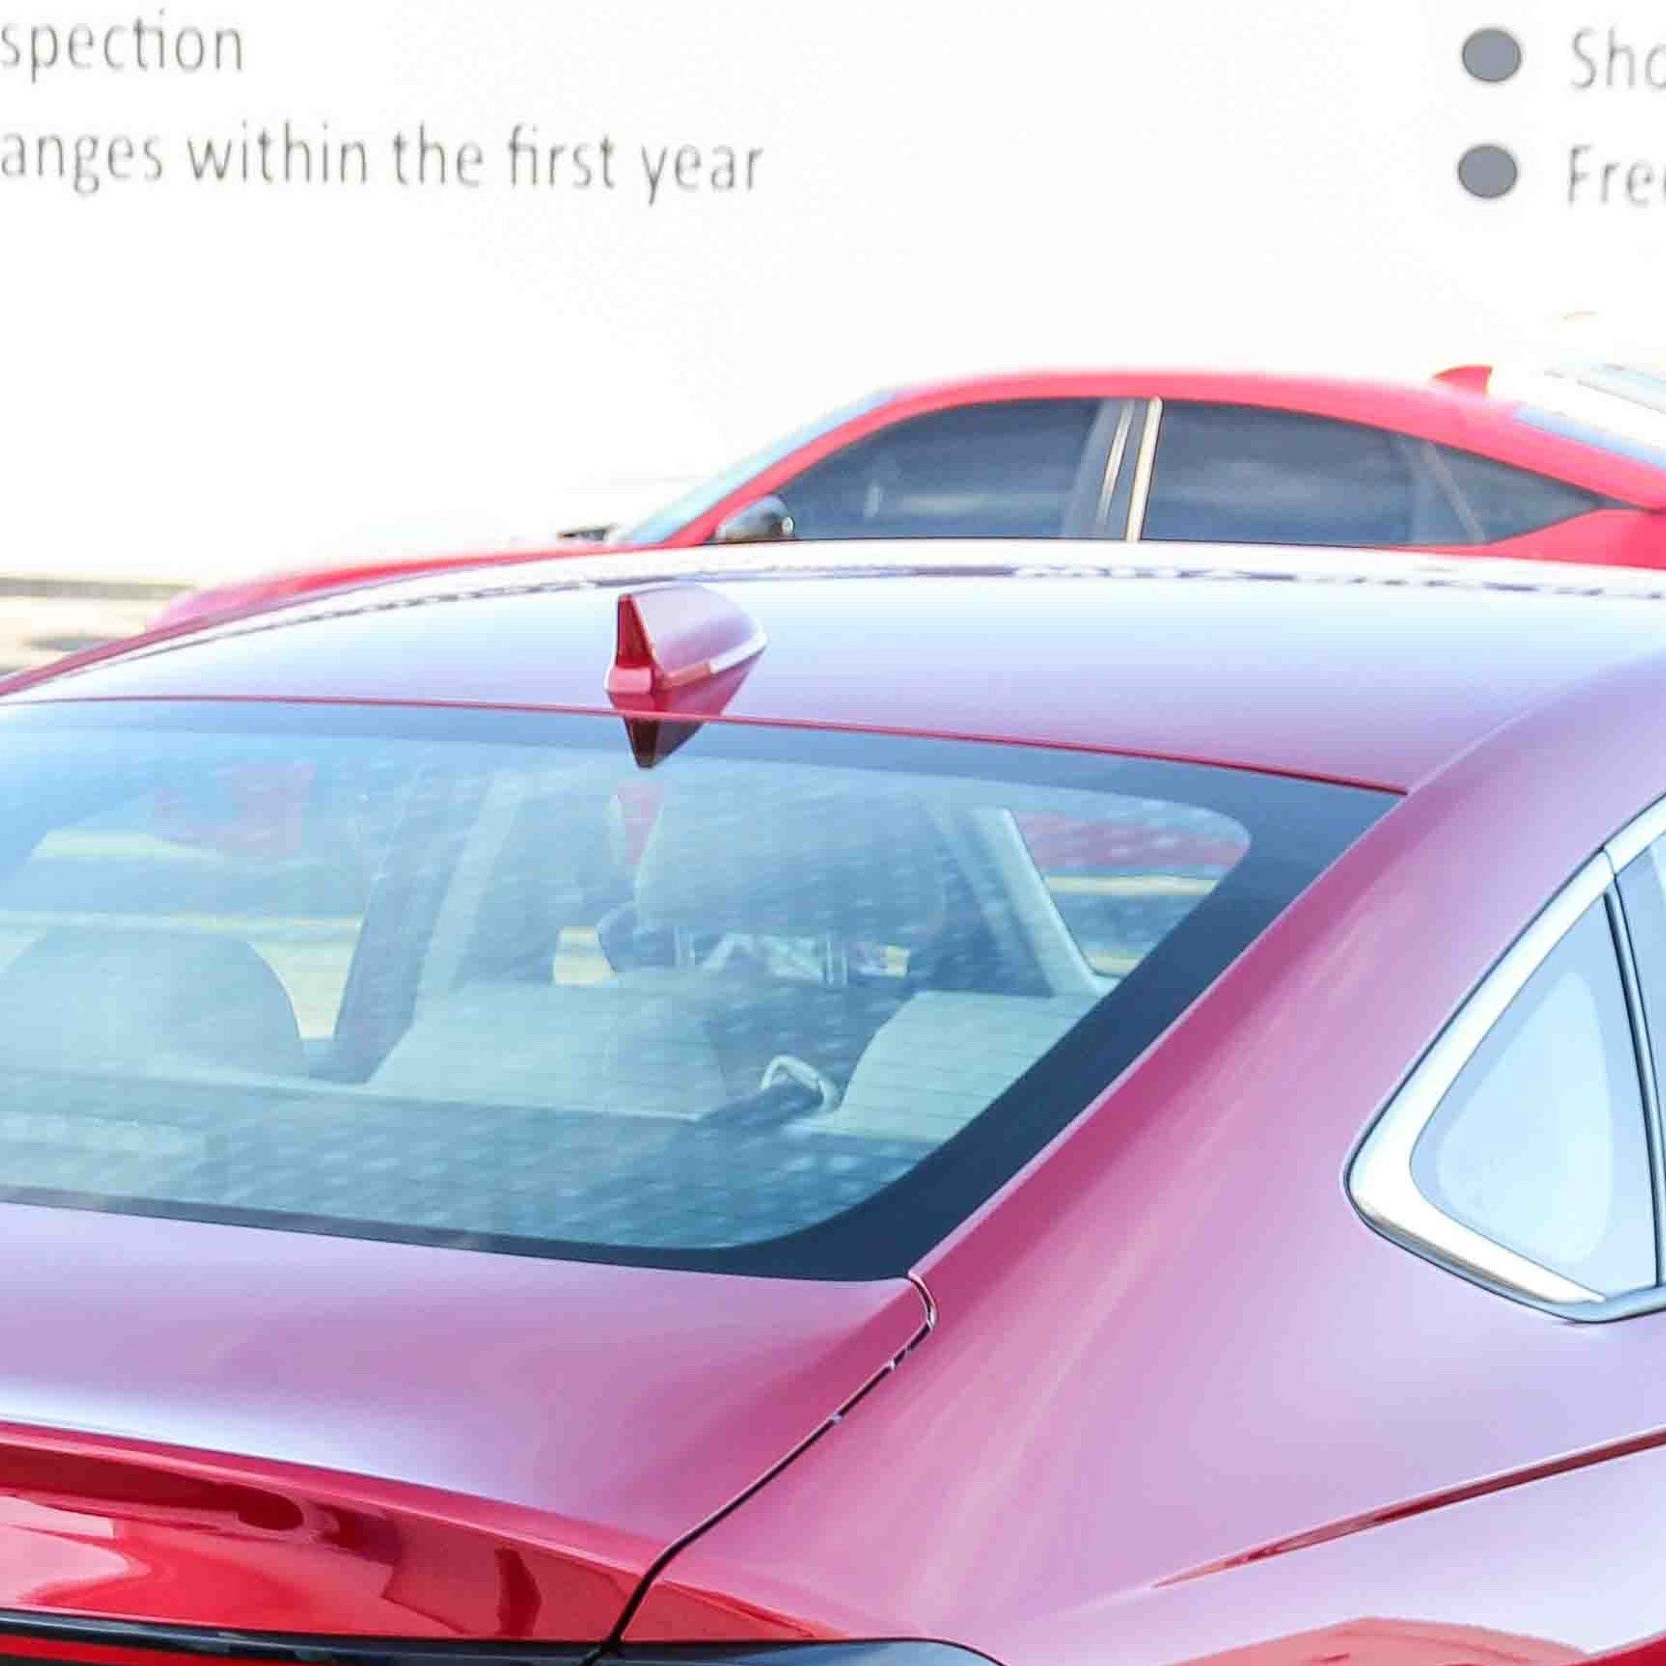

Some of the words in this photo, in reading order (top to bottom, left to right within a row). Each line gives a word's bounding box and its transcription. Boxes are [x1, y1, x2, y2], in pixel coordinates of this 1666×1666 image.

[186, 120, 368, 184] within
[392, 122, 484, 187] the
[507, 123, 615, 189] first
[640, 144, 764, 207] year
